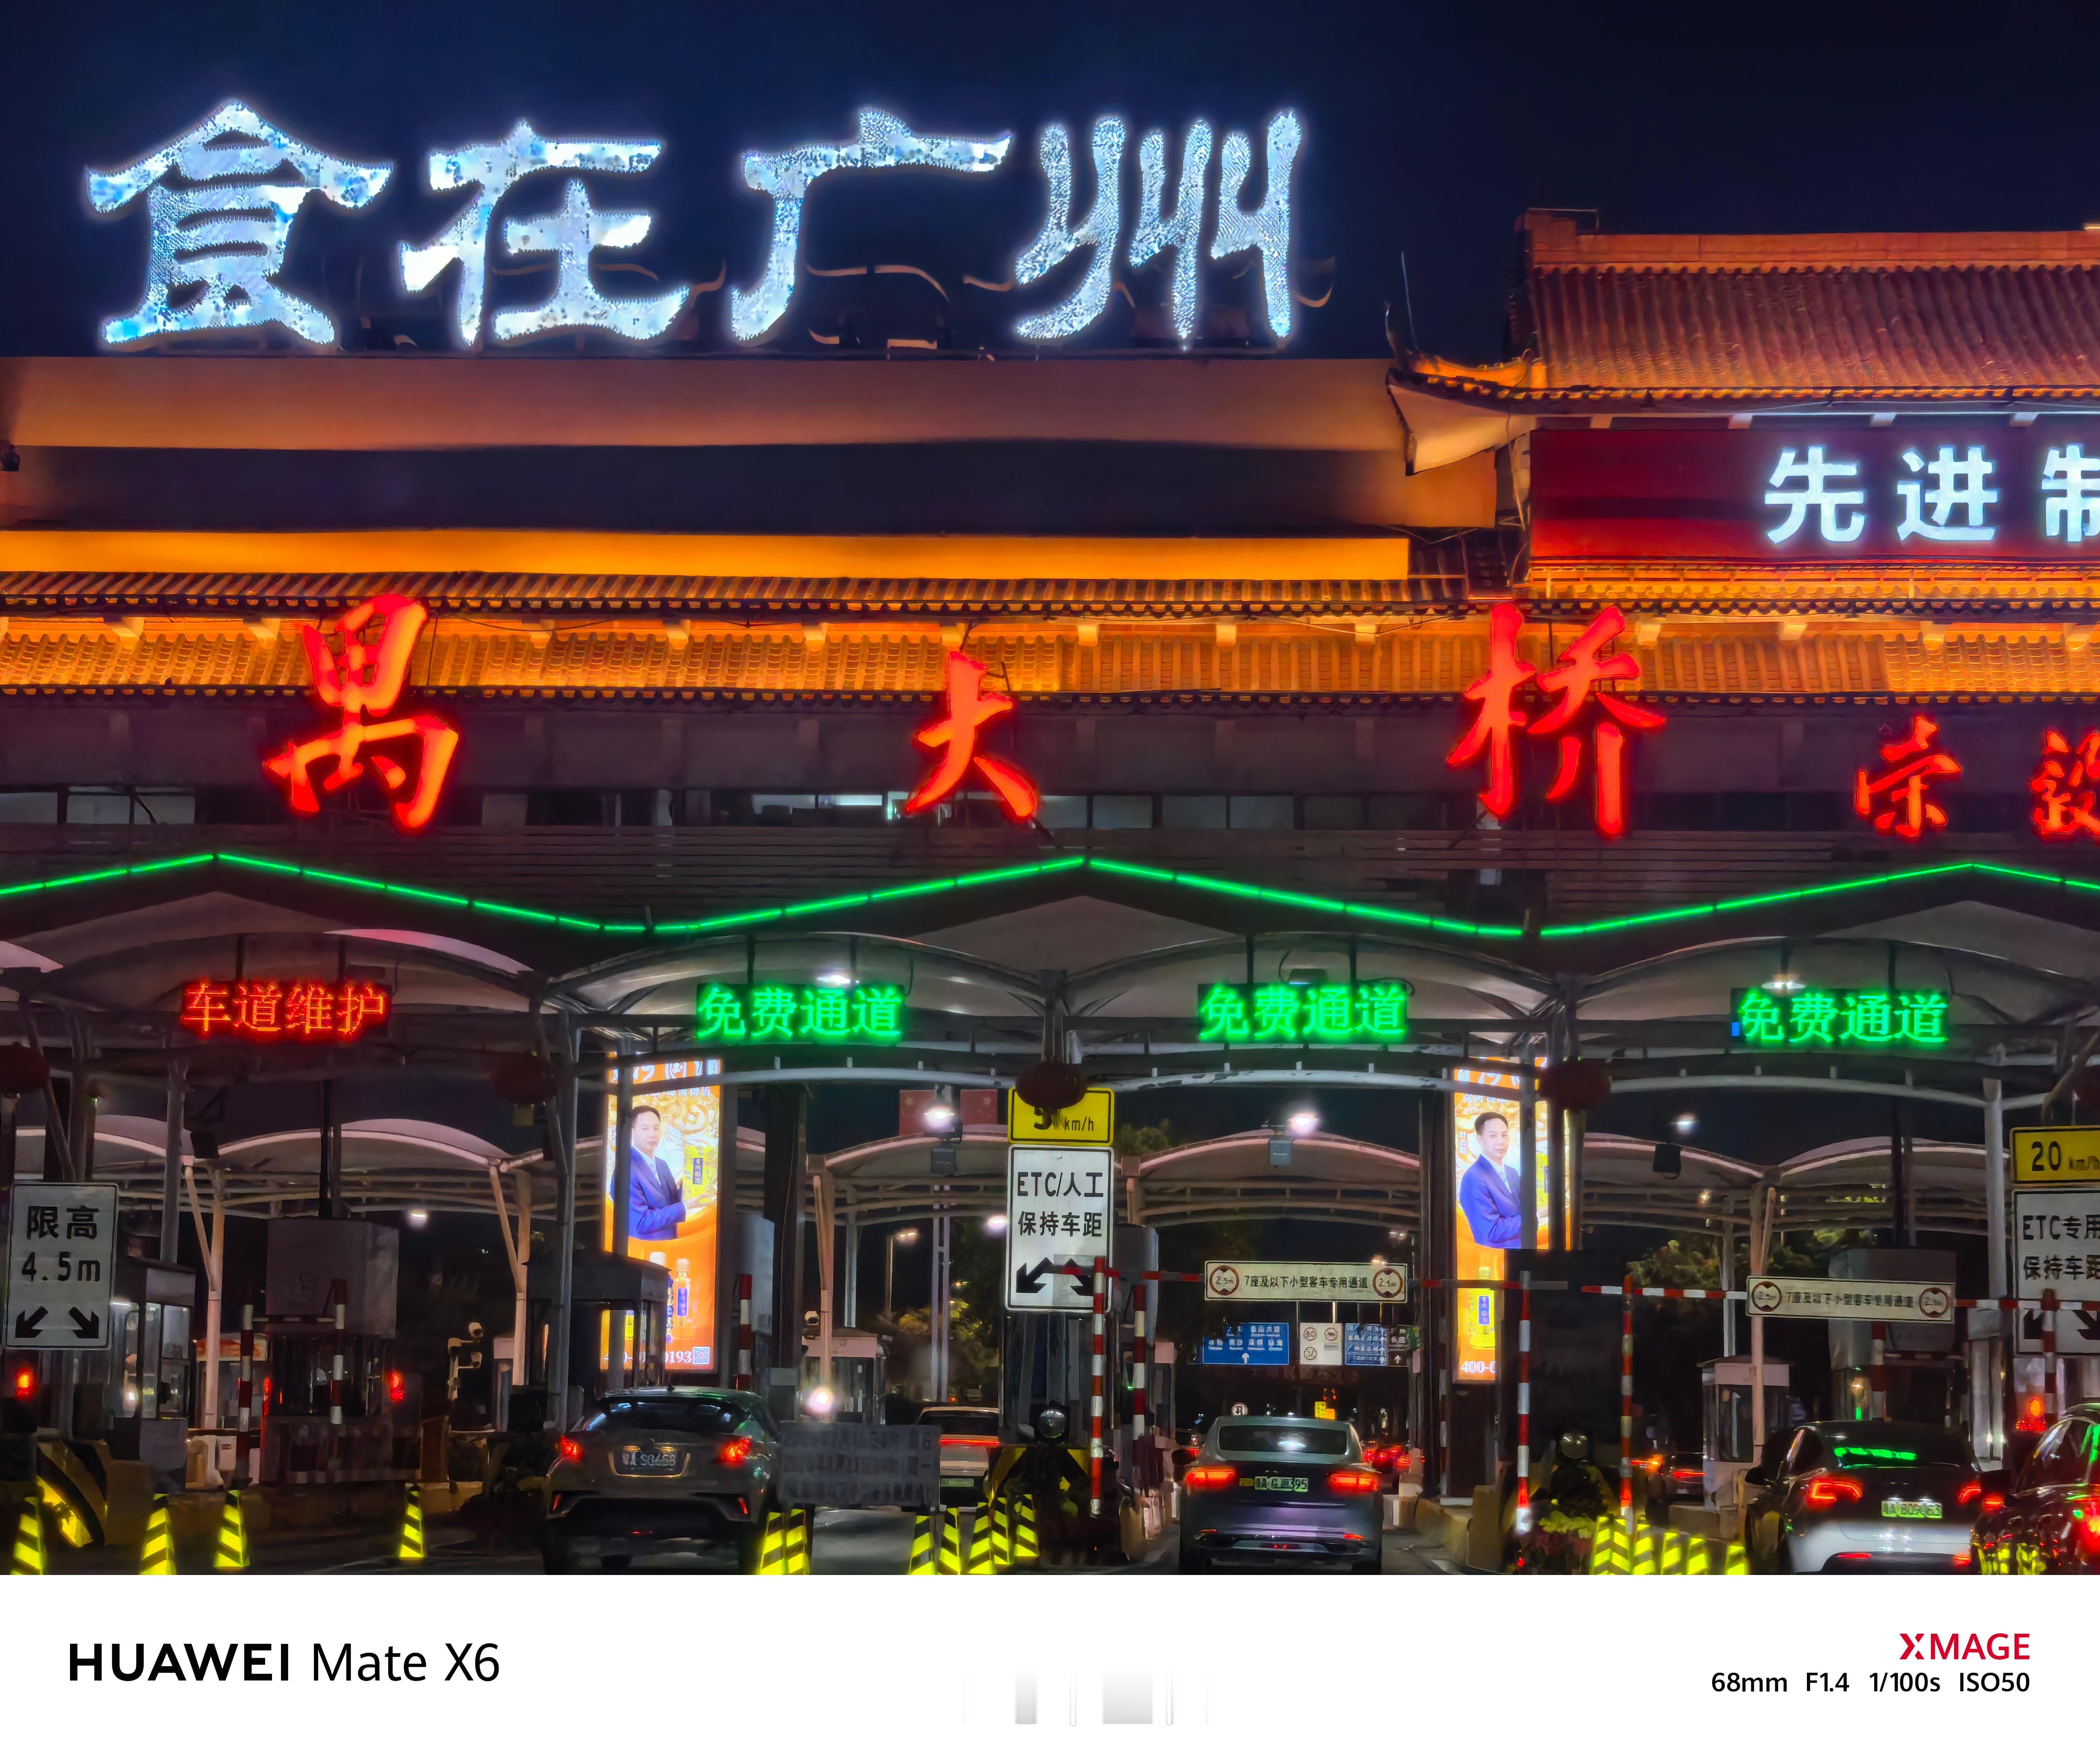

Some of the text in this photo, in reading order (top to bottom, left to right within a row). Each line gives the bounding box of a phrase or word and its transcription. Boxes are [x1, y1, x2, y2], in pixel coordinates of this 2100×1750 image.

[88, 98, 1303, 351] 食在广州
[1765, 443, 2100, 544] 先进制
[185, 983, 385, 1034] 车道维护
[696, 986, 903, 1039] 免费通道
[1199, 985, 1406, 1040] 免费通道
[1738, 990, 1948, 1043] 免费通道
[1064, 1116, 1094, 1132] km/h
[2031, 1141, 2062, 1171] 20
[1018, 1172, 1104, 1198] ETC/人工
[27, 1205, 100, 1240] 限高
[1018, 1211, 1102, 1237] 保持车距
[2023, 1214, 2100, 1240] ETC专用
[22, 1251, 101, 1282] 4.5m
